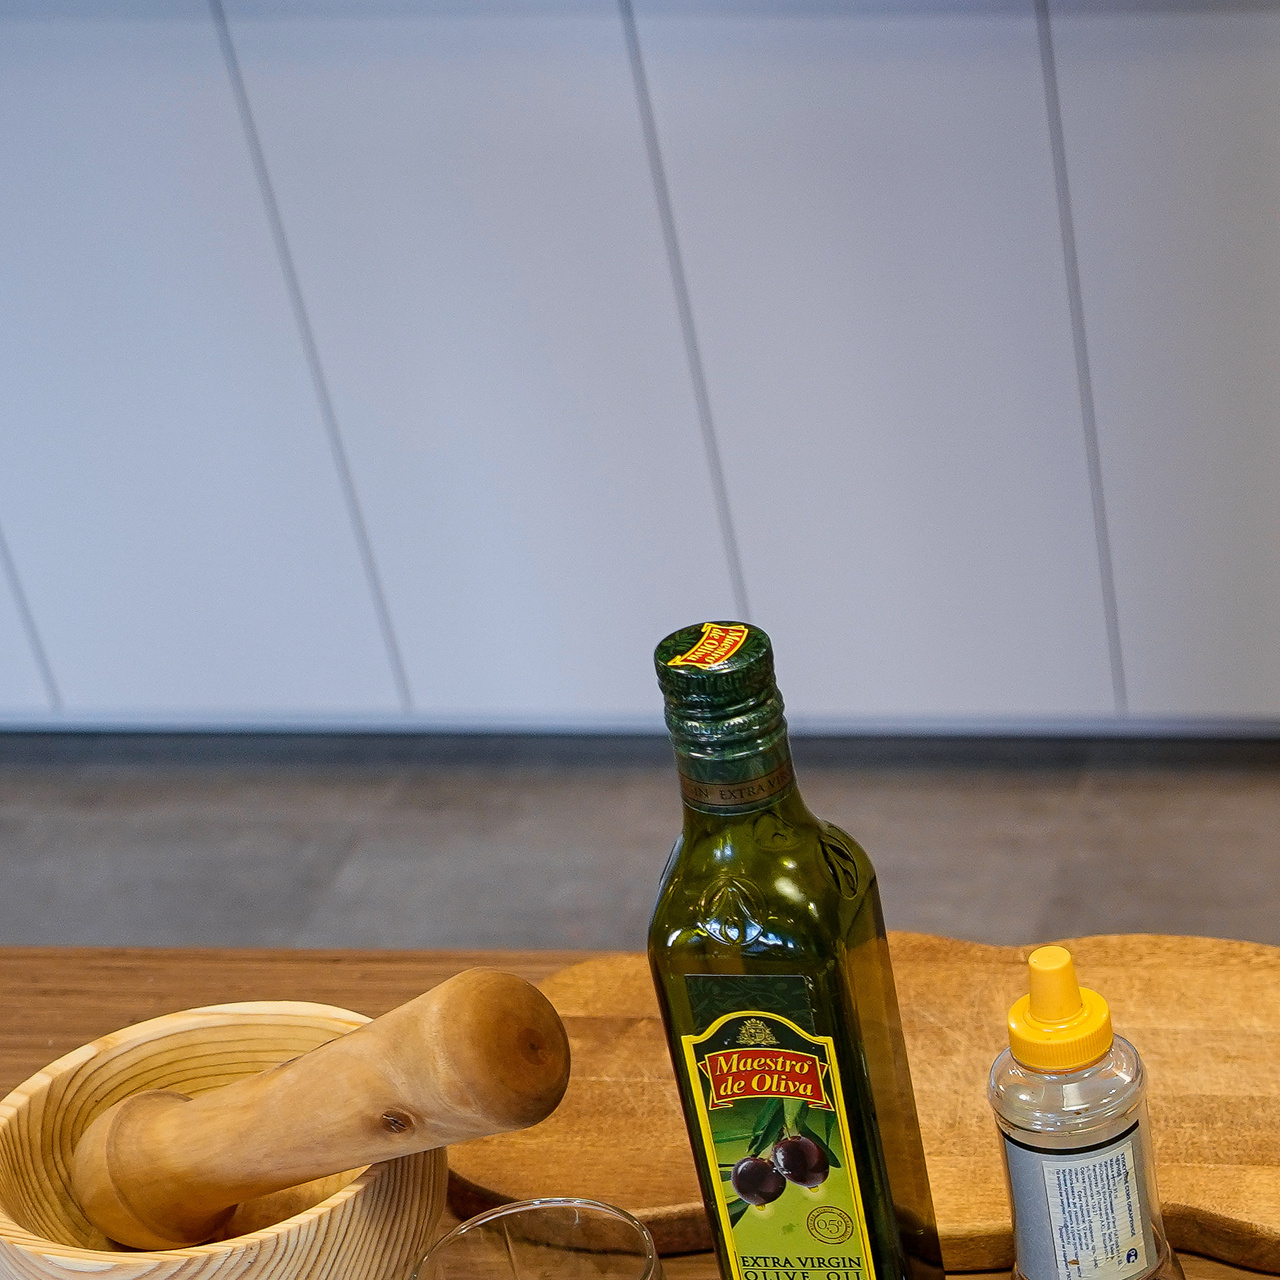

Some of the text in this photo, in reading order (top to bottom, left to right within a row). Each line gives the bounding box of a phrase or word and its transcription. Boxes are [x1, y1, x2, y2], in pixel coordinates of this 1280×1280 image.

[686, 628, 726, 661] de Oliva
[705, 630, 743, 663] Maestro
[719, 784, 765, 801] EXTRA
[715, 1053, 810, 1076] Maestro
[720, 1073, 814, 1097] de Oliva
[740, 1255, 862, 1269] EXTRA VIRGIN
